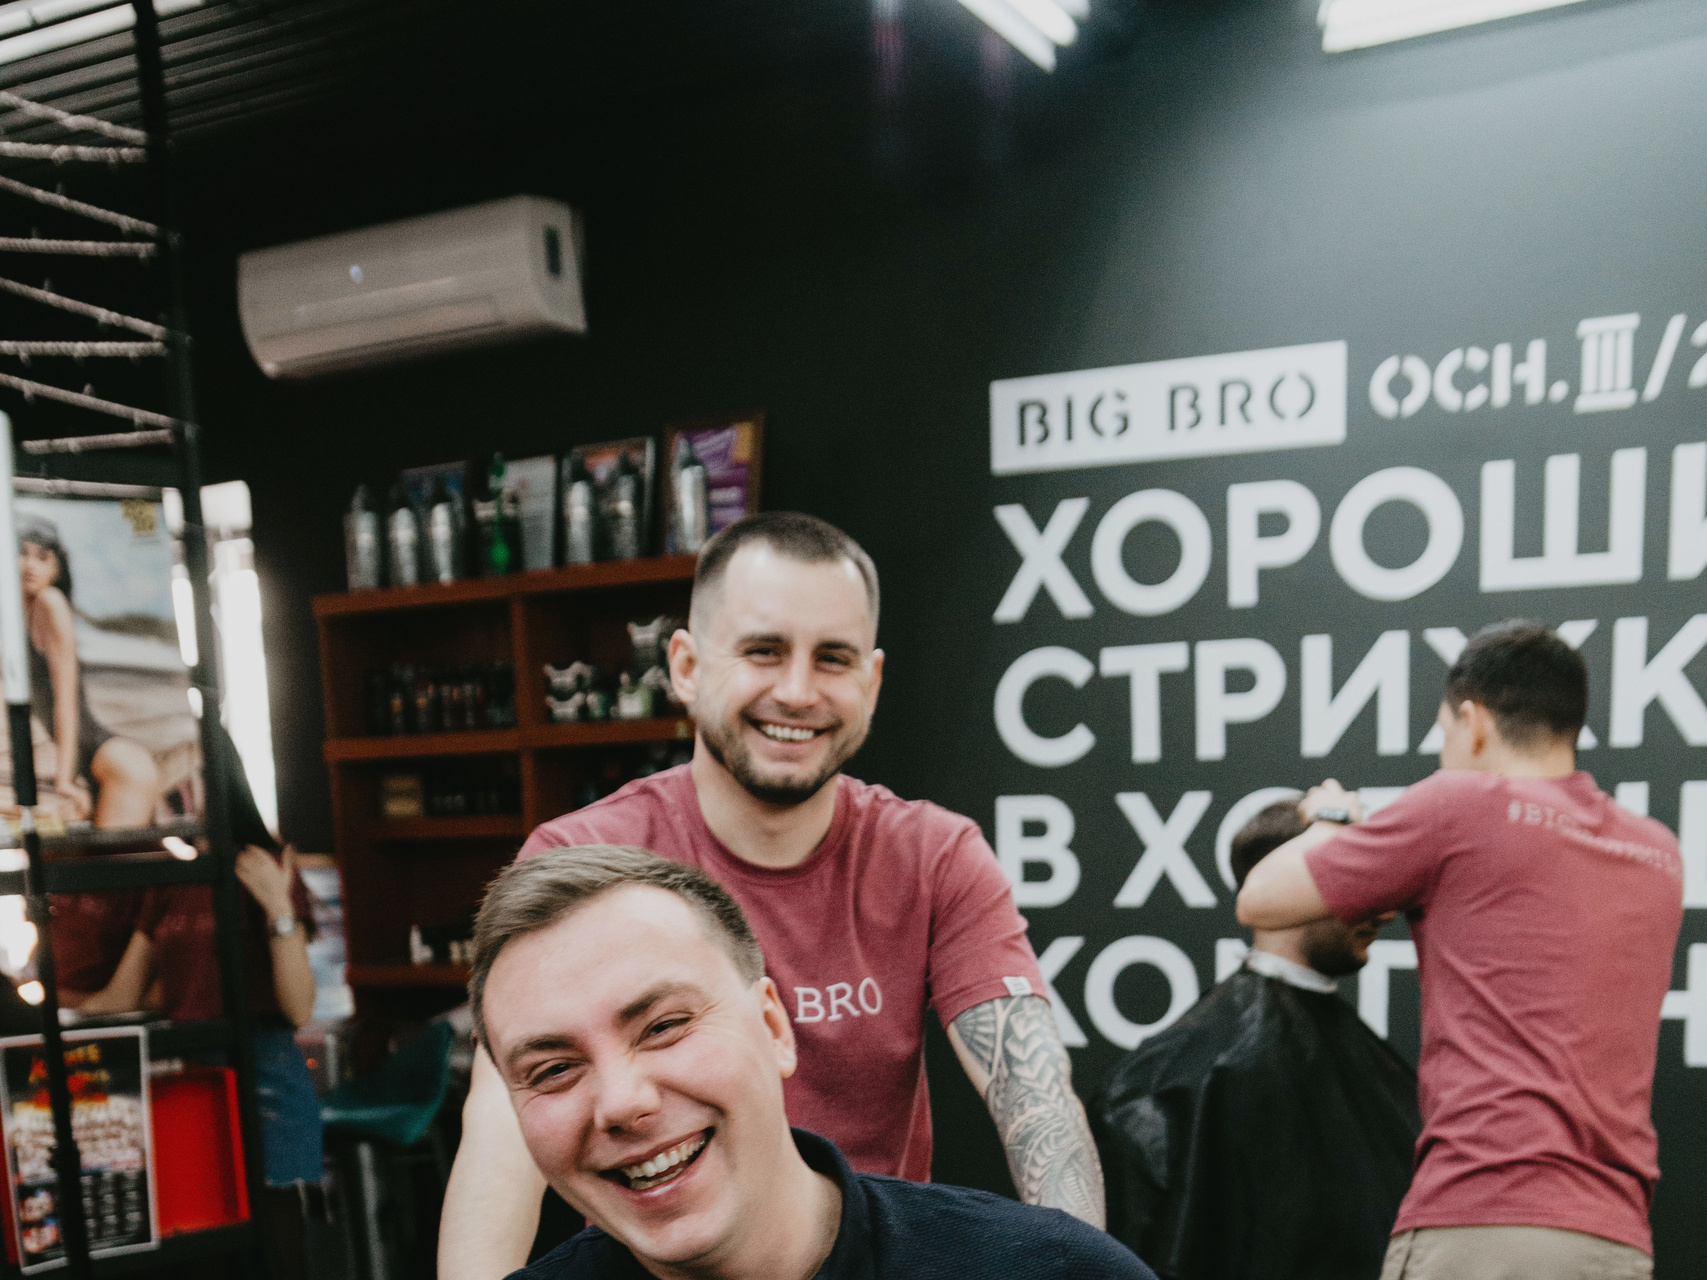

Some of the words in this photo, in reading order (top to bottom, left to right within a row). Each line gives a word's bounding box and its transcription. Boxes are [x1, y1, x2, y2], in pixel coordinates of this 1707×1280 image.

[1018, 389, 1130, 447] BIG
[1168, 370, 1316, 431] BRO
[993, 613, 1707, 768] СТРИК
[994, 794, 1081, 908] В
[793, 976, 883, 1024] BRO
